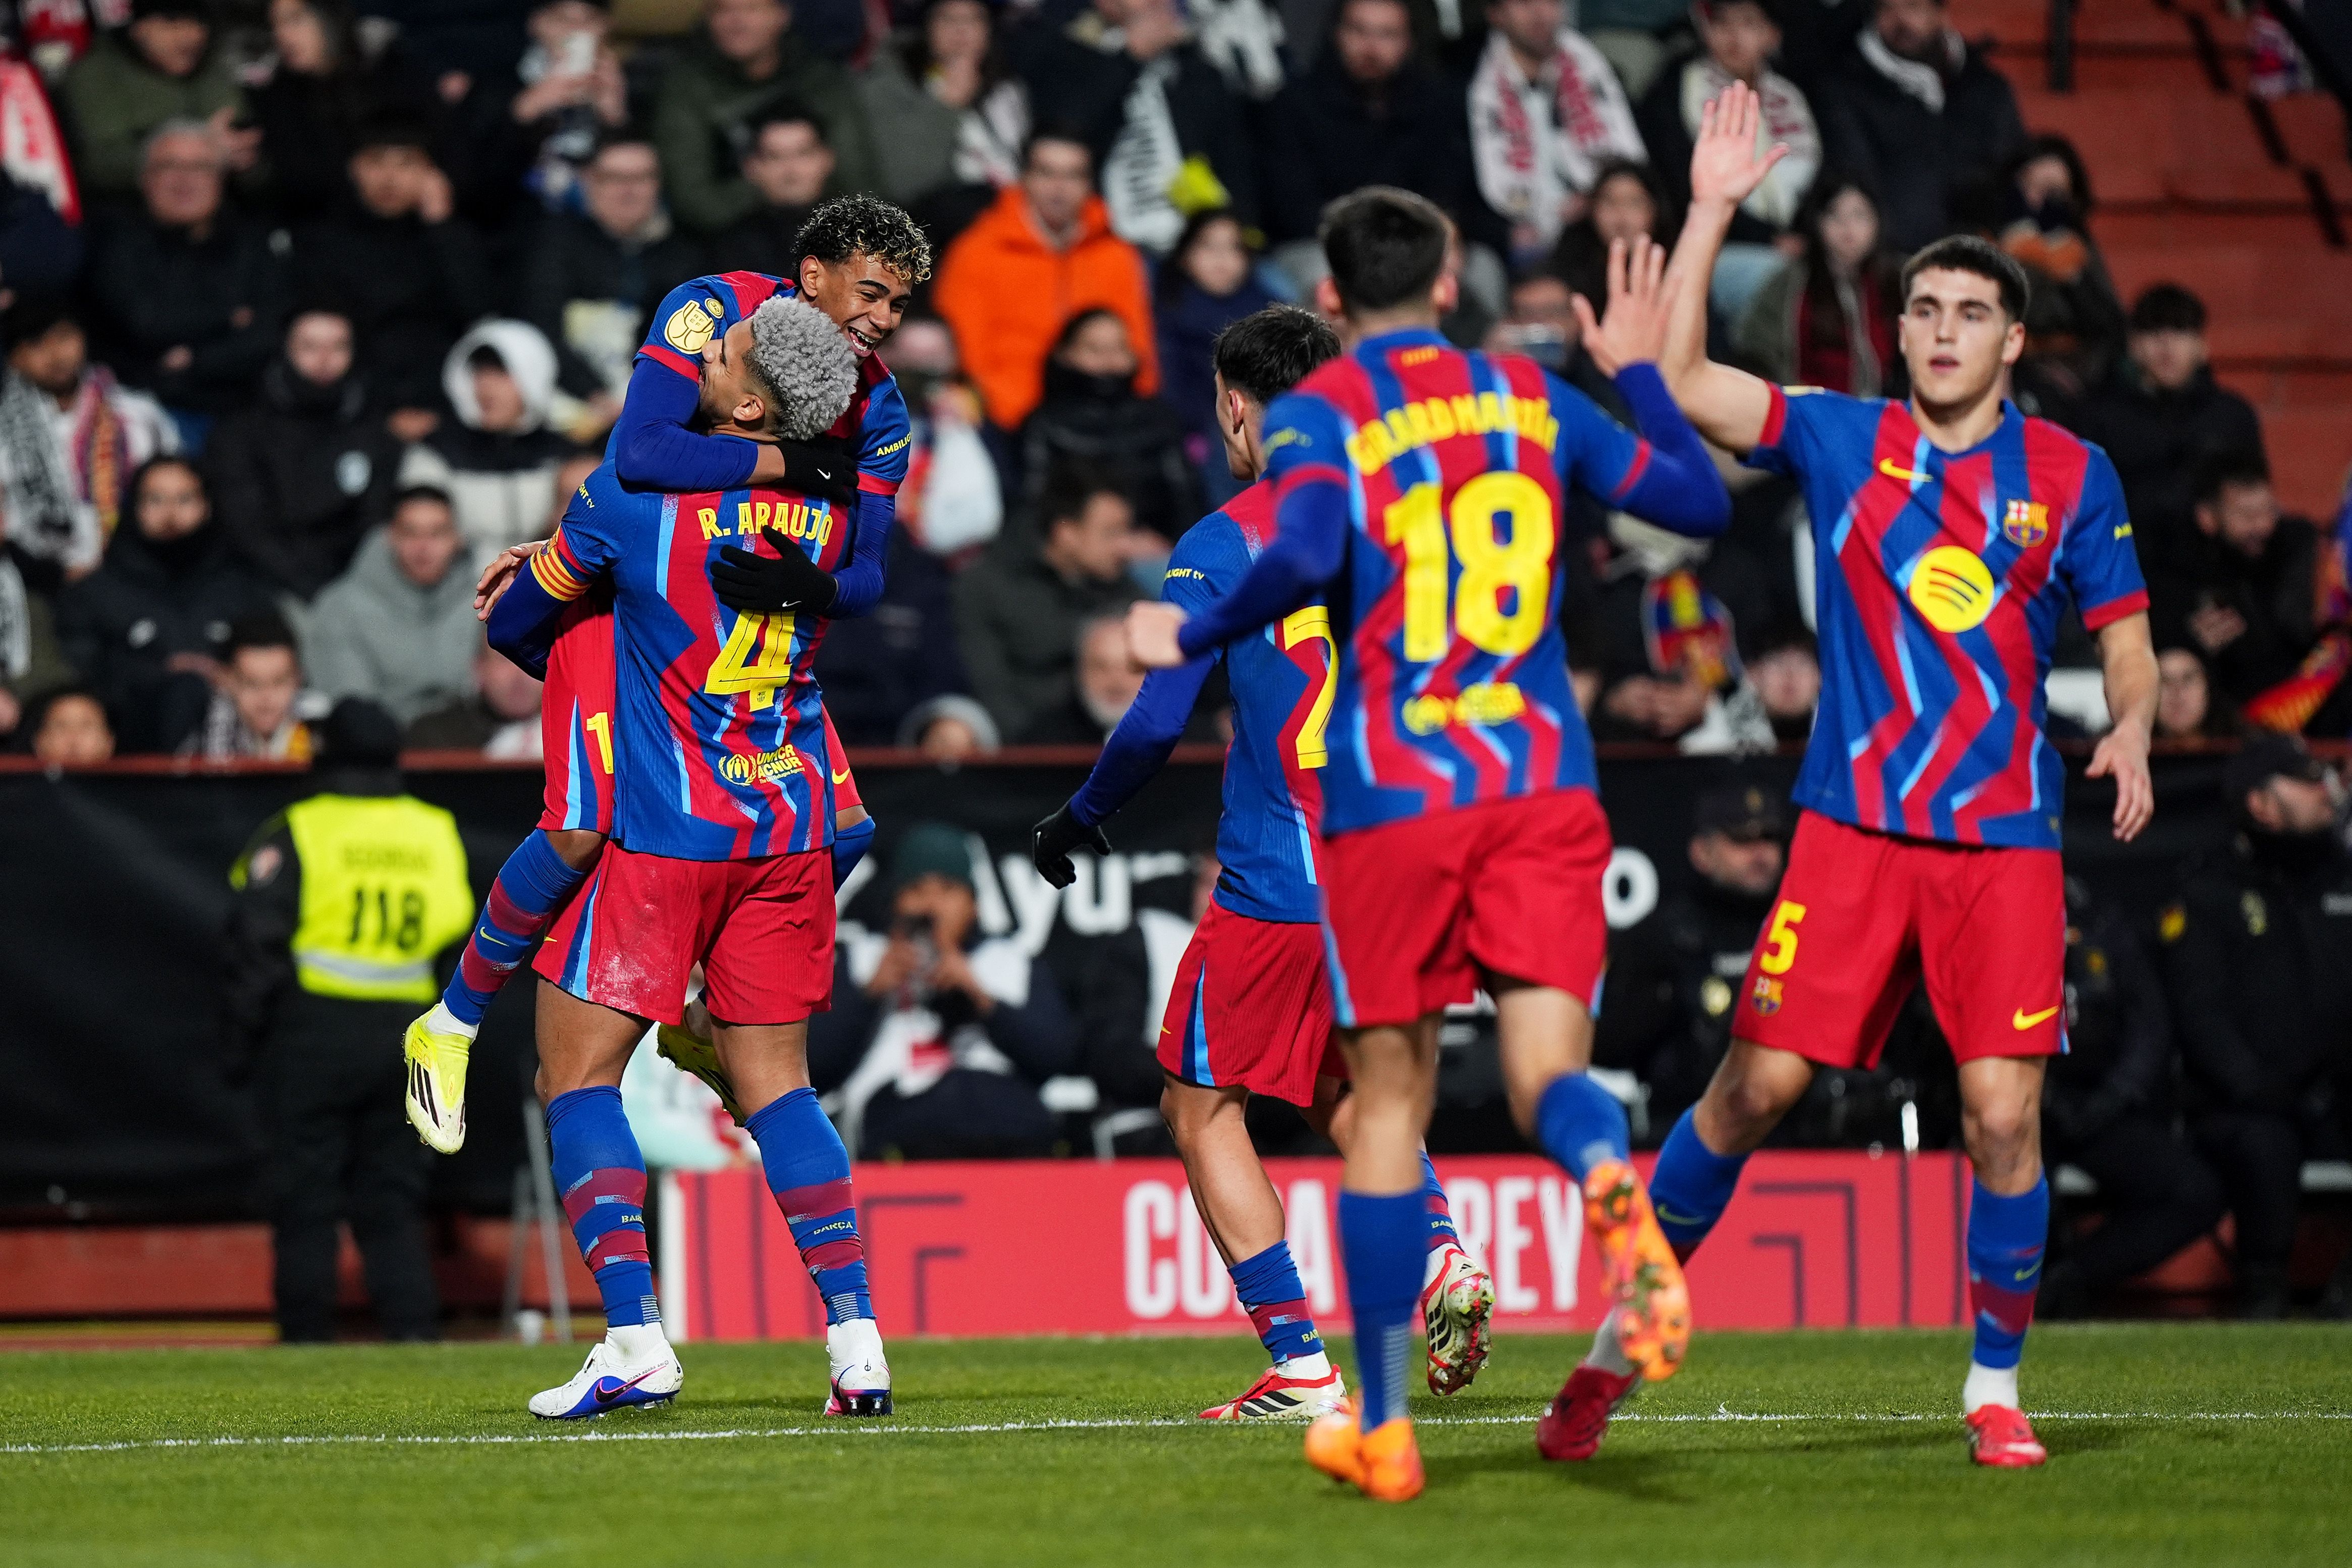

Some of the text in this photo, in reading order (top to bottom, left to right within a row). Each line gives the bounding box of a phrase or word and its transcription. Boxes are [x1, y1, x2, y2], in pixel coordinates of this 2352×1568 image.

[697, 502, 833, 546] R. ARAUJO
[1383, 470, 1554, 663] 18
[704, 609, 796, 712] 4
[758, 756, 803, 779] ACNUR
[1760, 900, 1807, 975] 5
[814, 1221, 853, 1235] BARÇA
[1125, 1180, 1337, 1318] COA
